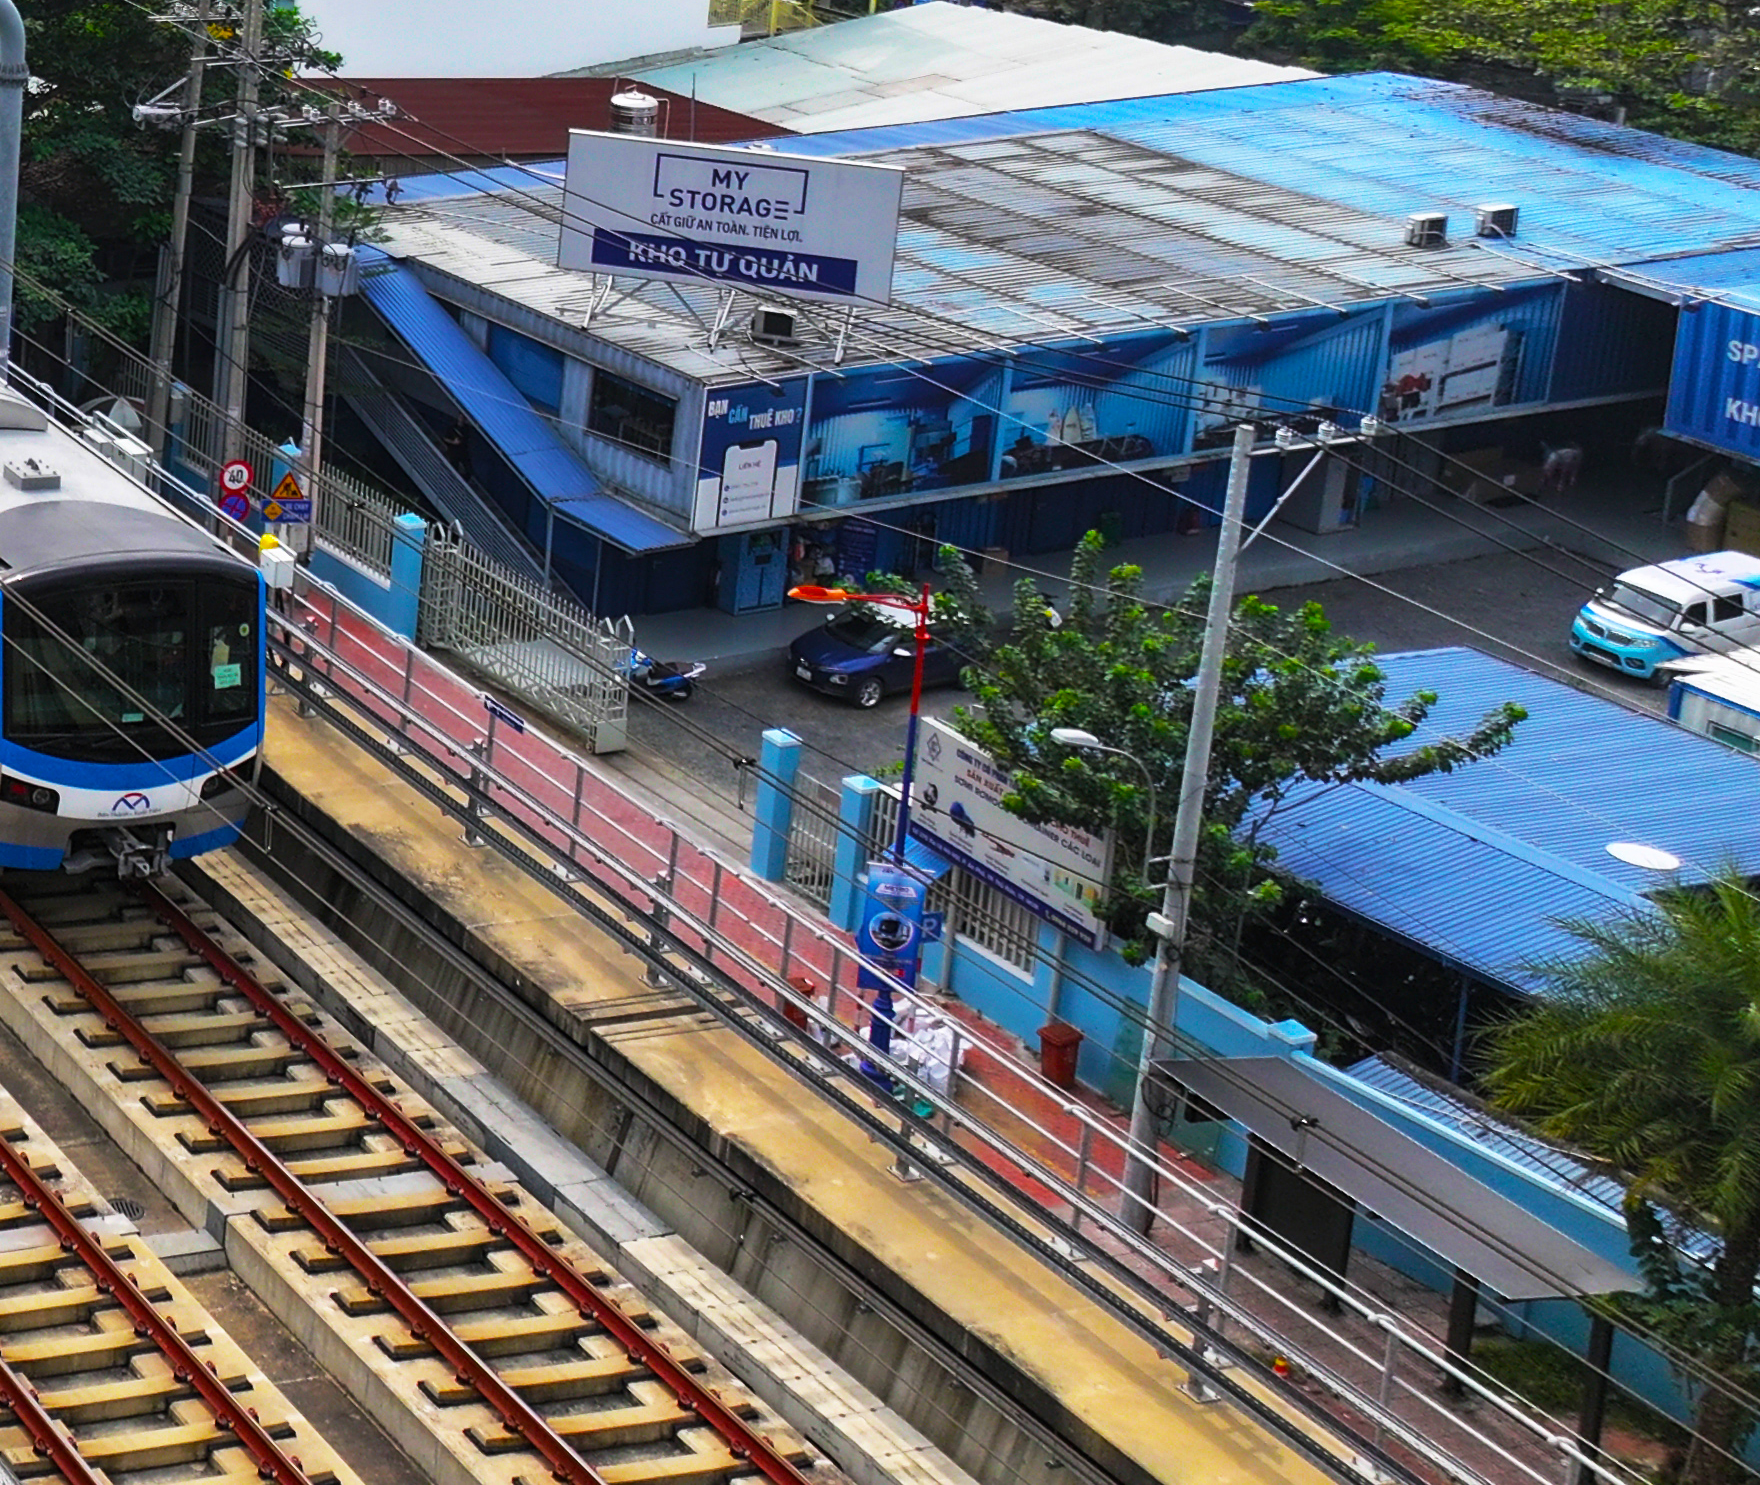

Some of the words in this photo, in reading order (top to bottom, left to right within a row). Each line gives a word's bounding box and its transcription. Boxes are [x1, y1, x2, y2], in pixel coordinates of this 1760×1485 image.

[711, 168, 749, 191] MY
[669, 188, 789, 221] STORAGE
[650, 212, 672, 226] CẤT
[673, 216, 696, 229] GIỮ
[696, 219, 713, 232] AN
[752, 225, 778, 241] TIỆN
[629, 240, 686, 266] KHO
[695, 248, 735, 277] TỰ
[738, 254, 818, 283] QUẢN
[1726, 339, 1760, 369] SP
[708, 399, 729, 419] BẠN
[728, 403, 748, 424] CẦN
[749, 407, 774, 431] THUÊ
[774, 408, 795, 427] KHO
[1724, 396, 1760, 427] KH
[228, 469, 244, 484] 40
